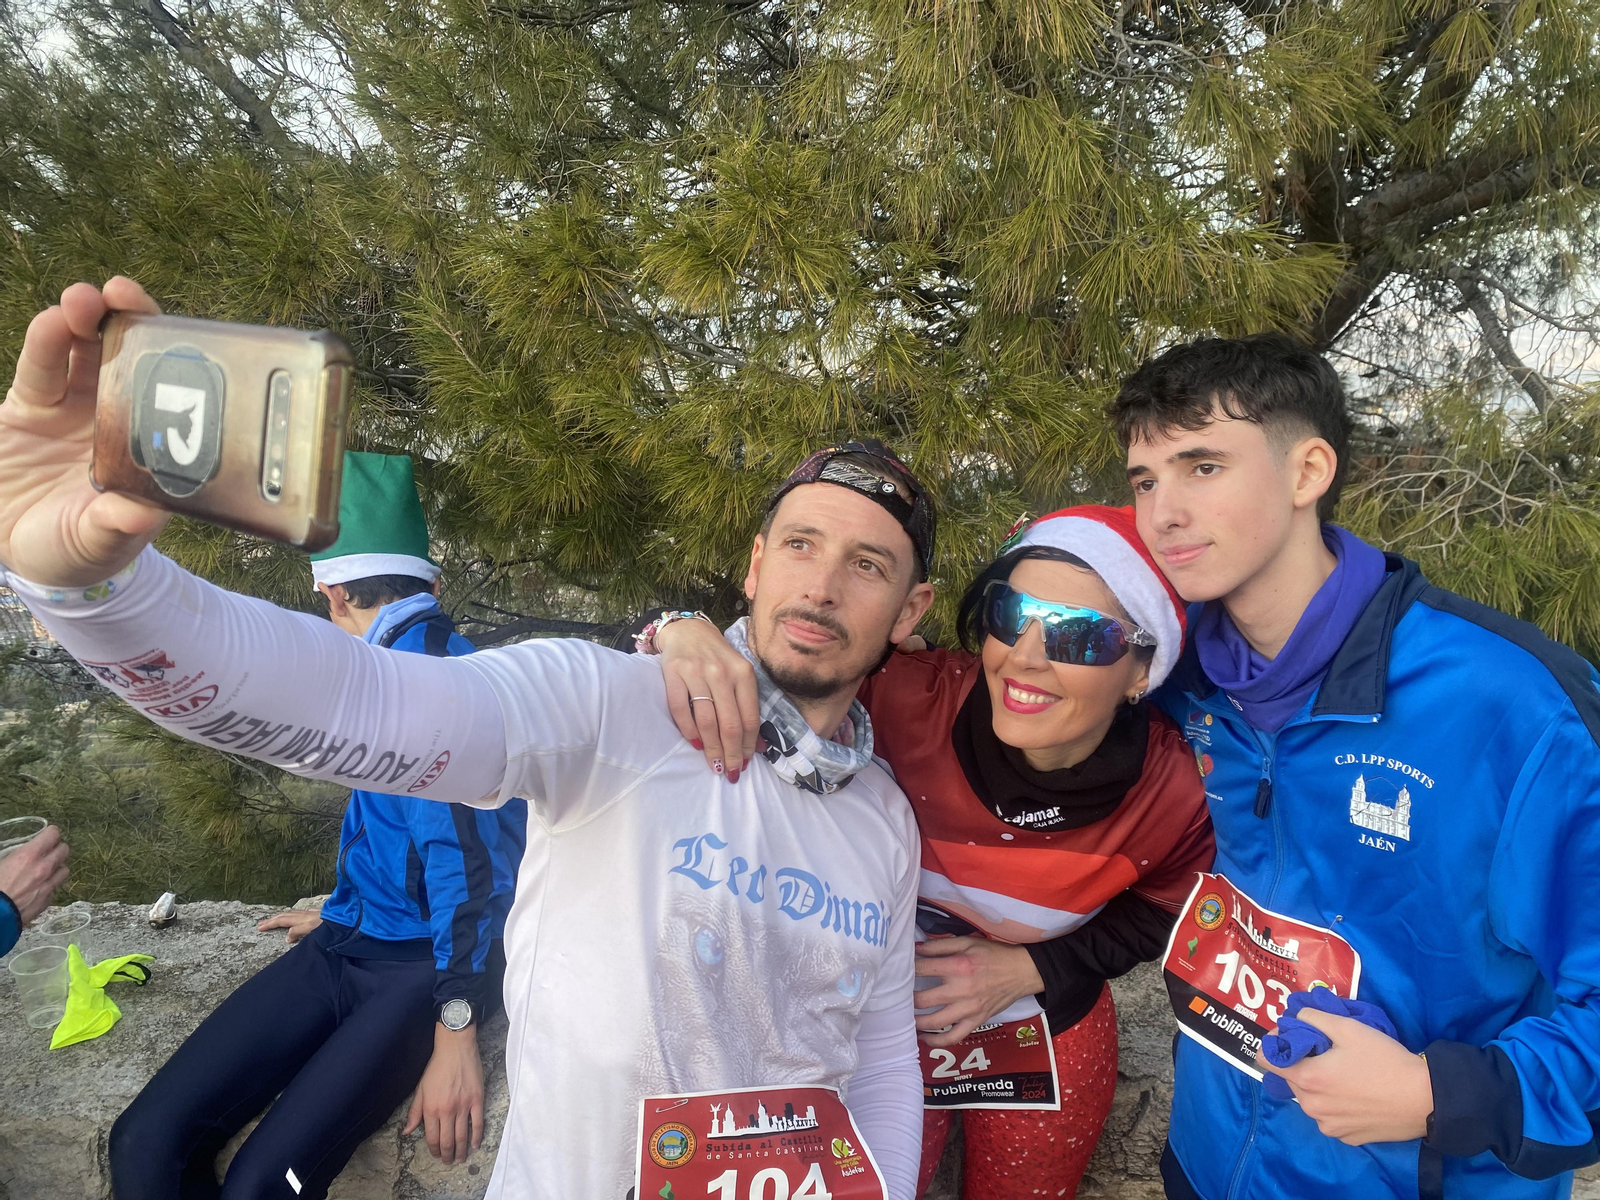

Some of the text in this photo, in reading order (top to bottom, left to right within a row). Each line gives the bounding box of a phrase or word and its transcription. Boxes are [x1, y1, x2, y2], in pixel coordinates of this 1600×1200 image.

[1334, 753, 1436, 790] C.D. LPP SPORTS
[1003, 806, 1061, 827] cajamar
[1358, 833, 1396, 853] JAÉN
[667, 832, 768, 904] Leo
[1255, 949, 1298, 976] Castillo
[1214, 950, 1291, 1024] 103
[1202, 1005, 1262, 1048] PubliPren
[929, 1046, 992, 1078] 24
[933, 1079, 1014, 1097] PubliPrenda
[981, 1090, 1015, 1098] Promowear
[1021, 1089, 1047, 1100] 2024
[796, 1118, 817, 1128] XXVII
[705, 1135, 823, 1153] Subida al Castillo
[706, 1144, 824, 1161] de Santa Catalina
[706, 1162, 833, 1200] 104
